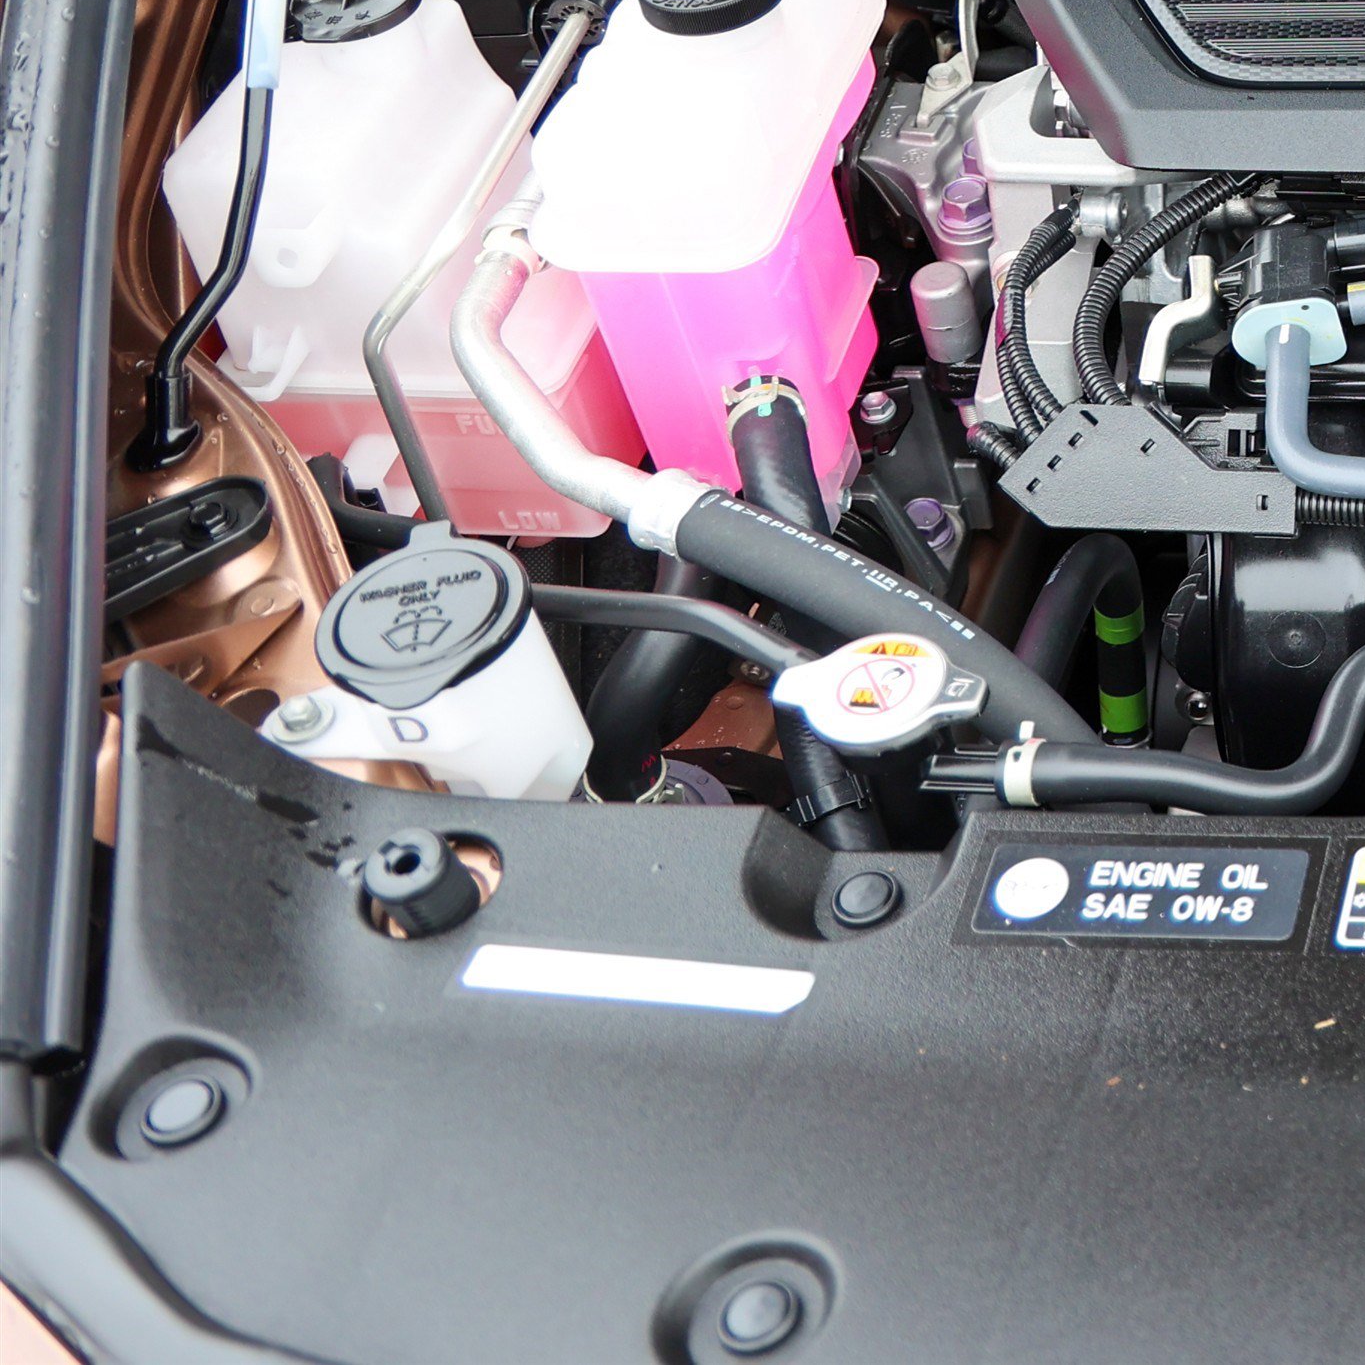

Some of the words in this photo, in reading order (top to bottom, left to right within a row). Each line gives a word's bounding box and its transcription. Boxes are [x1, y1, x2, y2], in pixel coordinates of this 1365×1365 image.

[455, 413, 506, 436] FU
[497, 509, 561, 531] LOW
[360, 579, 427, 603] WASHER
[436, 569, 482, 588] FLUID
[398, 589, 440, 606] ONLY
[387, 716, 429, 742] D
[1087, 860, 1205, 889] ENGINE
[1219, 863, 1269, 890] OIL
[1080, 892, 1153, 921] SAE
[1170, 895, 1255, 923] 0W-8
